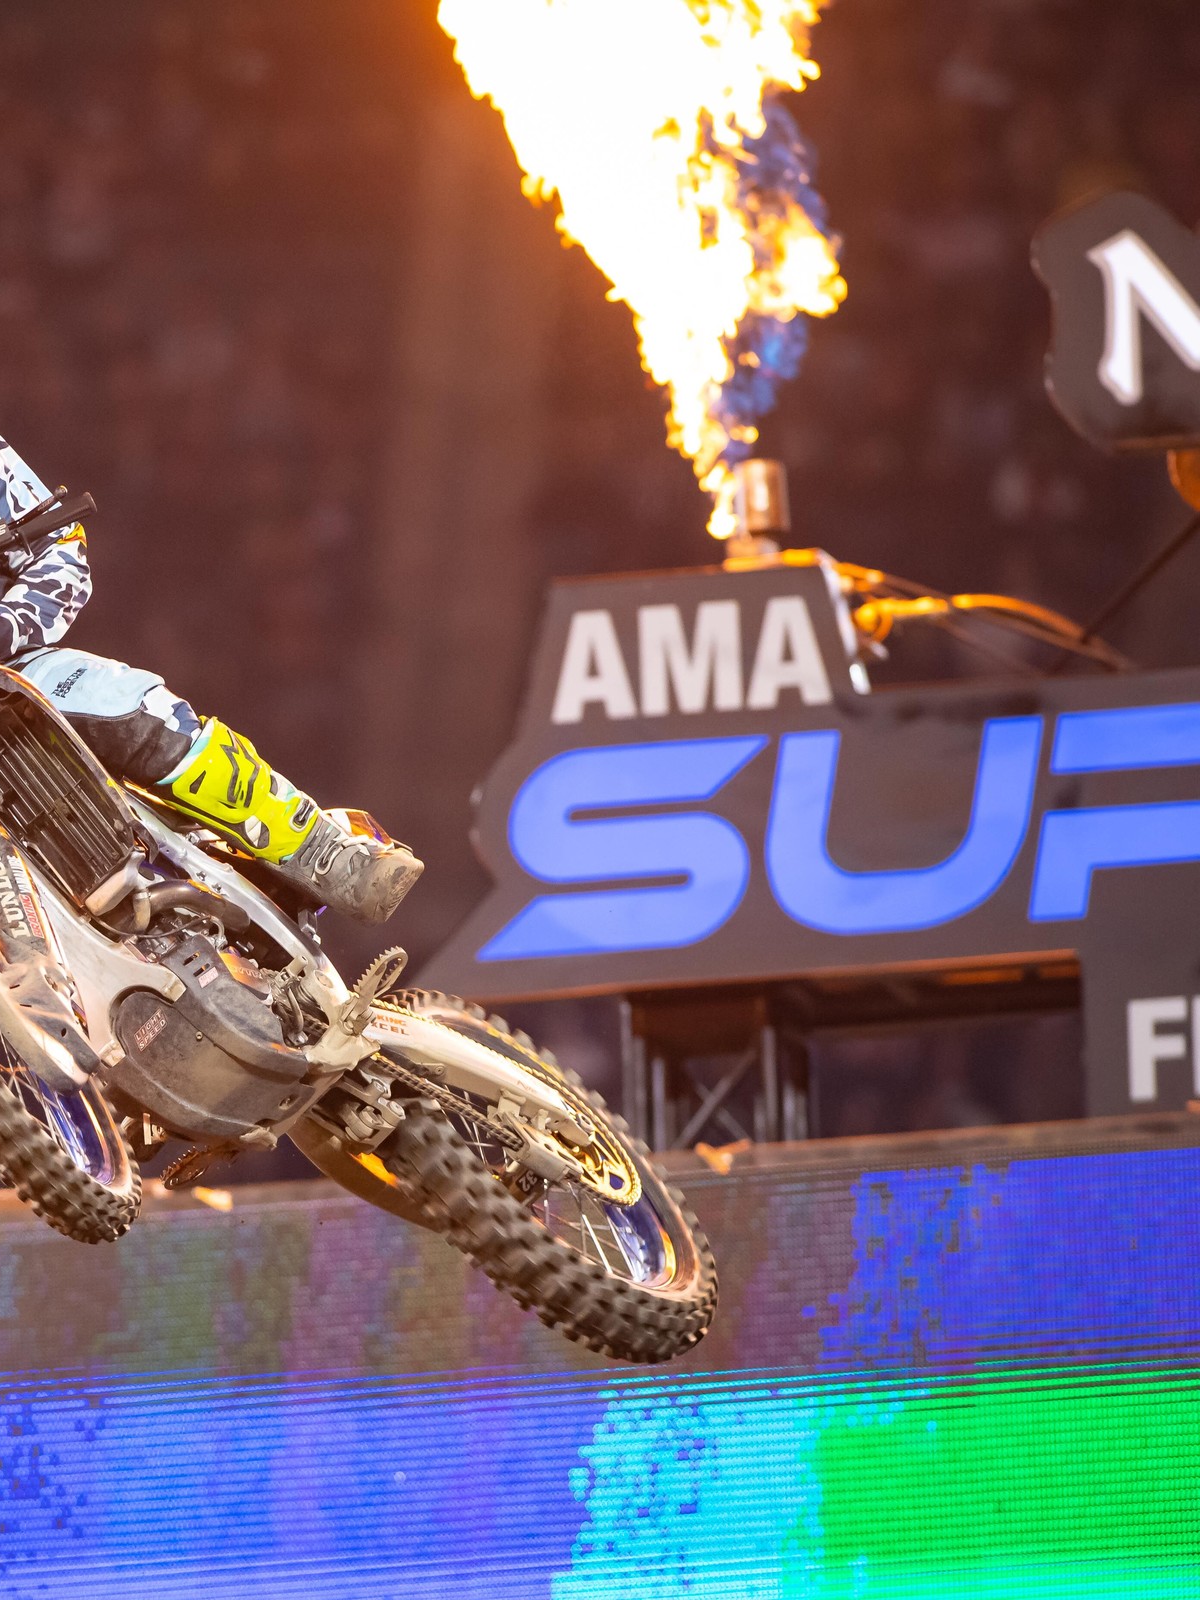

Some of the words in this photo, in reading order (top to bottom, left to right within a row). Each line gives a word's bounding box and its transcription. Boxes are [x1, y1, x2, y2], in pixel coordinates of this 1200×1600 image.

[551, 596, 833, 724] AMA
[475, 702, 1200, 961] SUP
[20, 893, 45, 939] BRAKING
[135, 1010, 161, 1041] LIGHT
[139, 1019, 166, 1049] SPEED
[1127, 994, 1200, 1103] F
